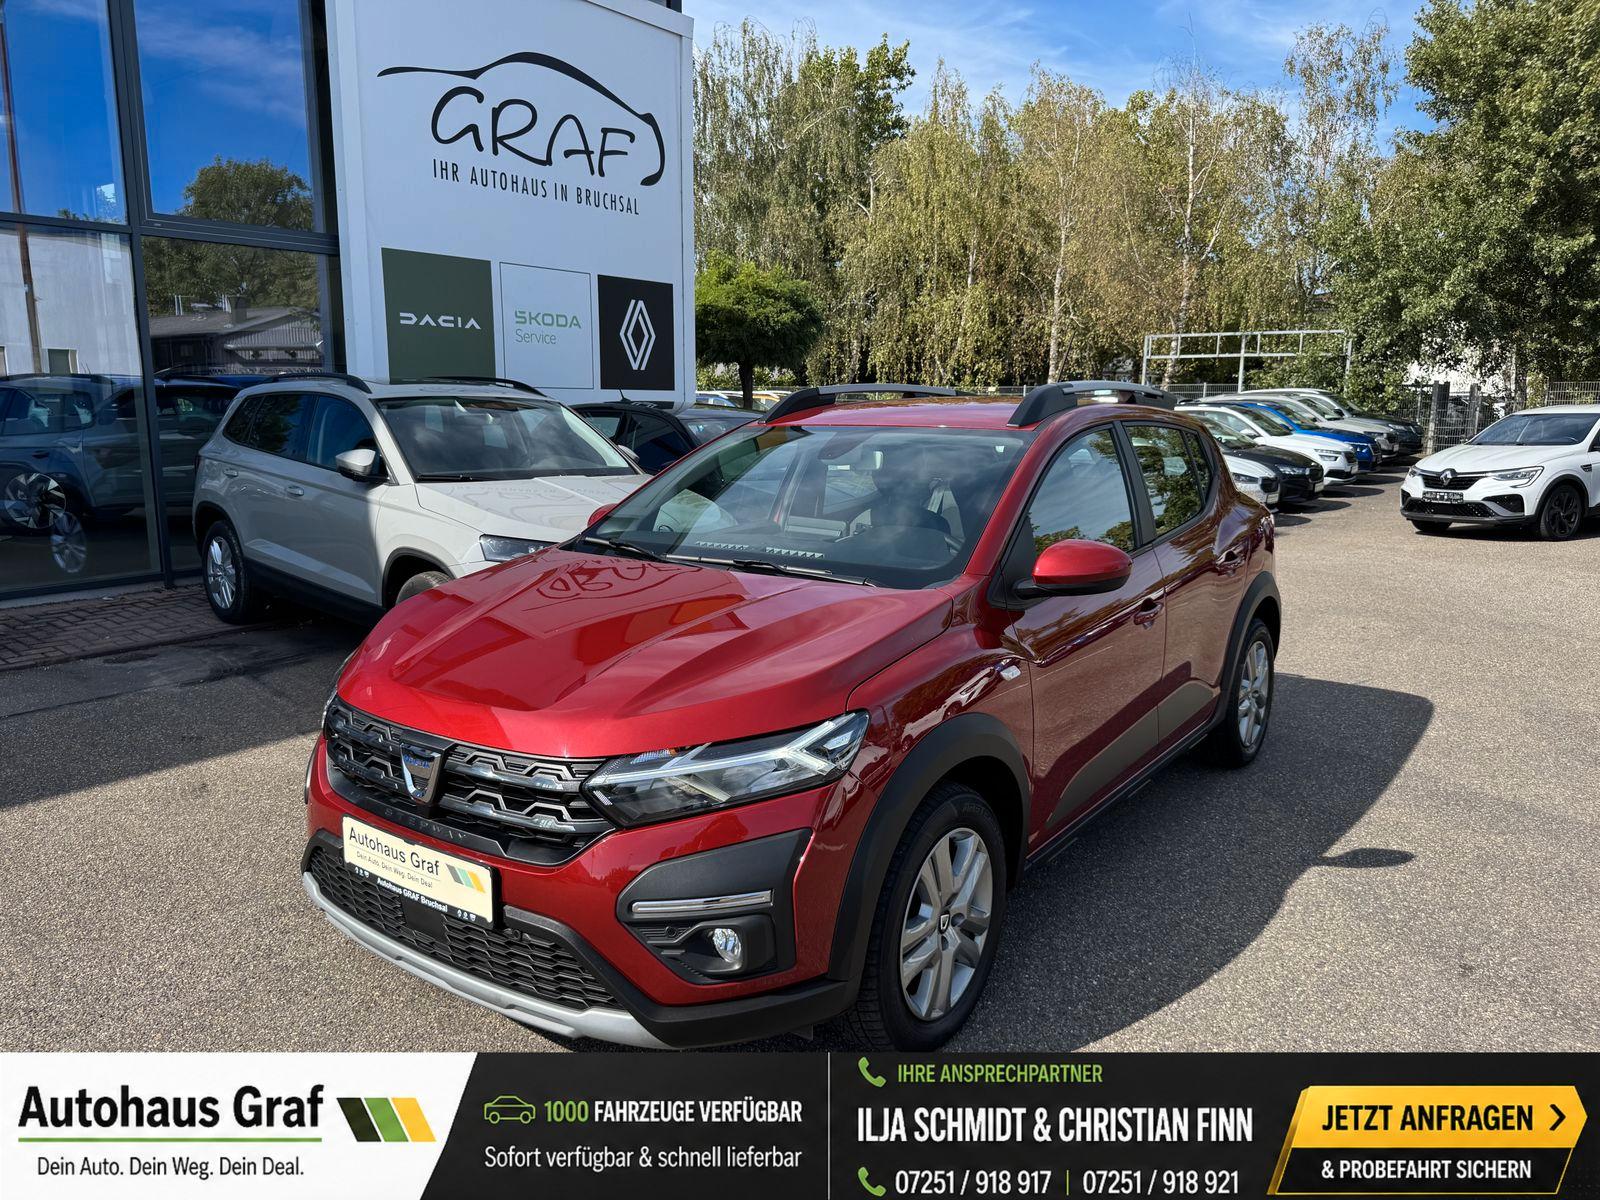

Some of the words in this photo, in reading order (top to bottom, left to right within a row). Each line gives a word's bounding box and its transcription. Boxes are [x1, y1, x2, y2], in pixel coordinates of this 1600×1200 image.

[431, 86, 635, 177] GRAF
[433, 158, 460, 182] IHR
[470, 165, 547, 198] AUTOHAUS
[554, 182, 568, 202] IN
[576, 186, 640, 216] BRUCHSAL
[399, 312, 482, 330] DACIA
[515, 328, 557, 345] Service
[349, 827, 406, 863] Autohaus
[410, 851, 440, 876] Graf
[376, 877, 403, 895] Autohaus
[402, 888, 421, 902] GRAF
[420, 895, 449, 913] Bruchsal
